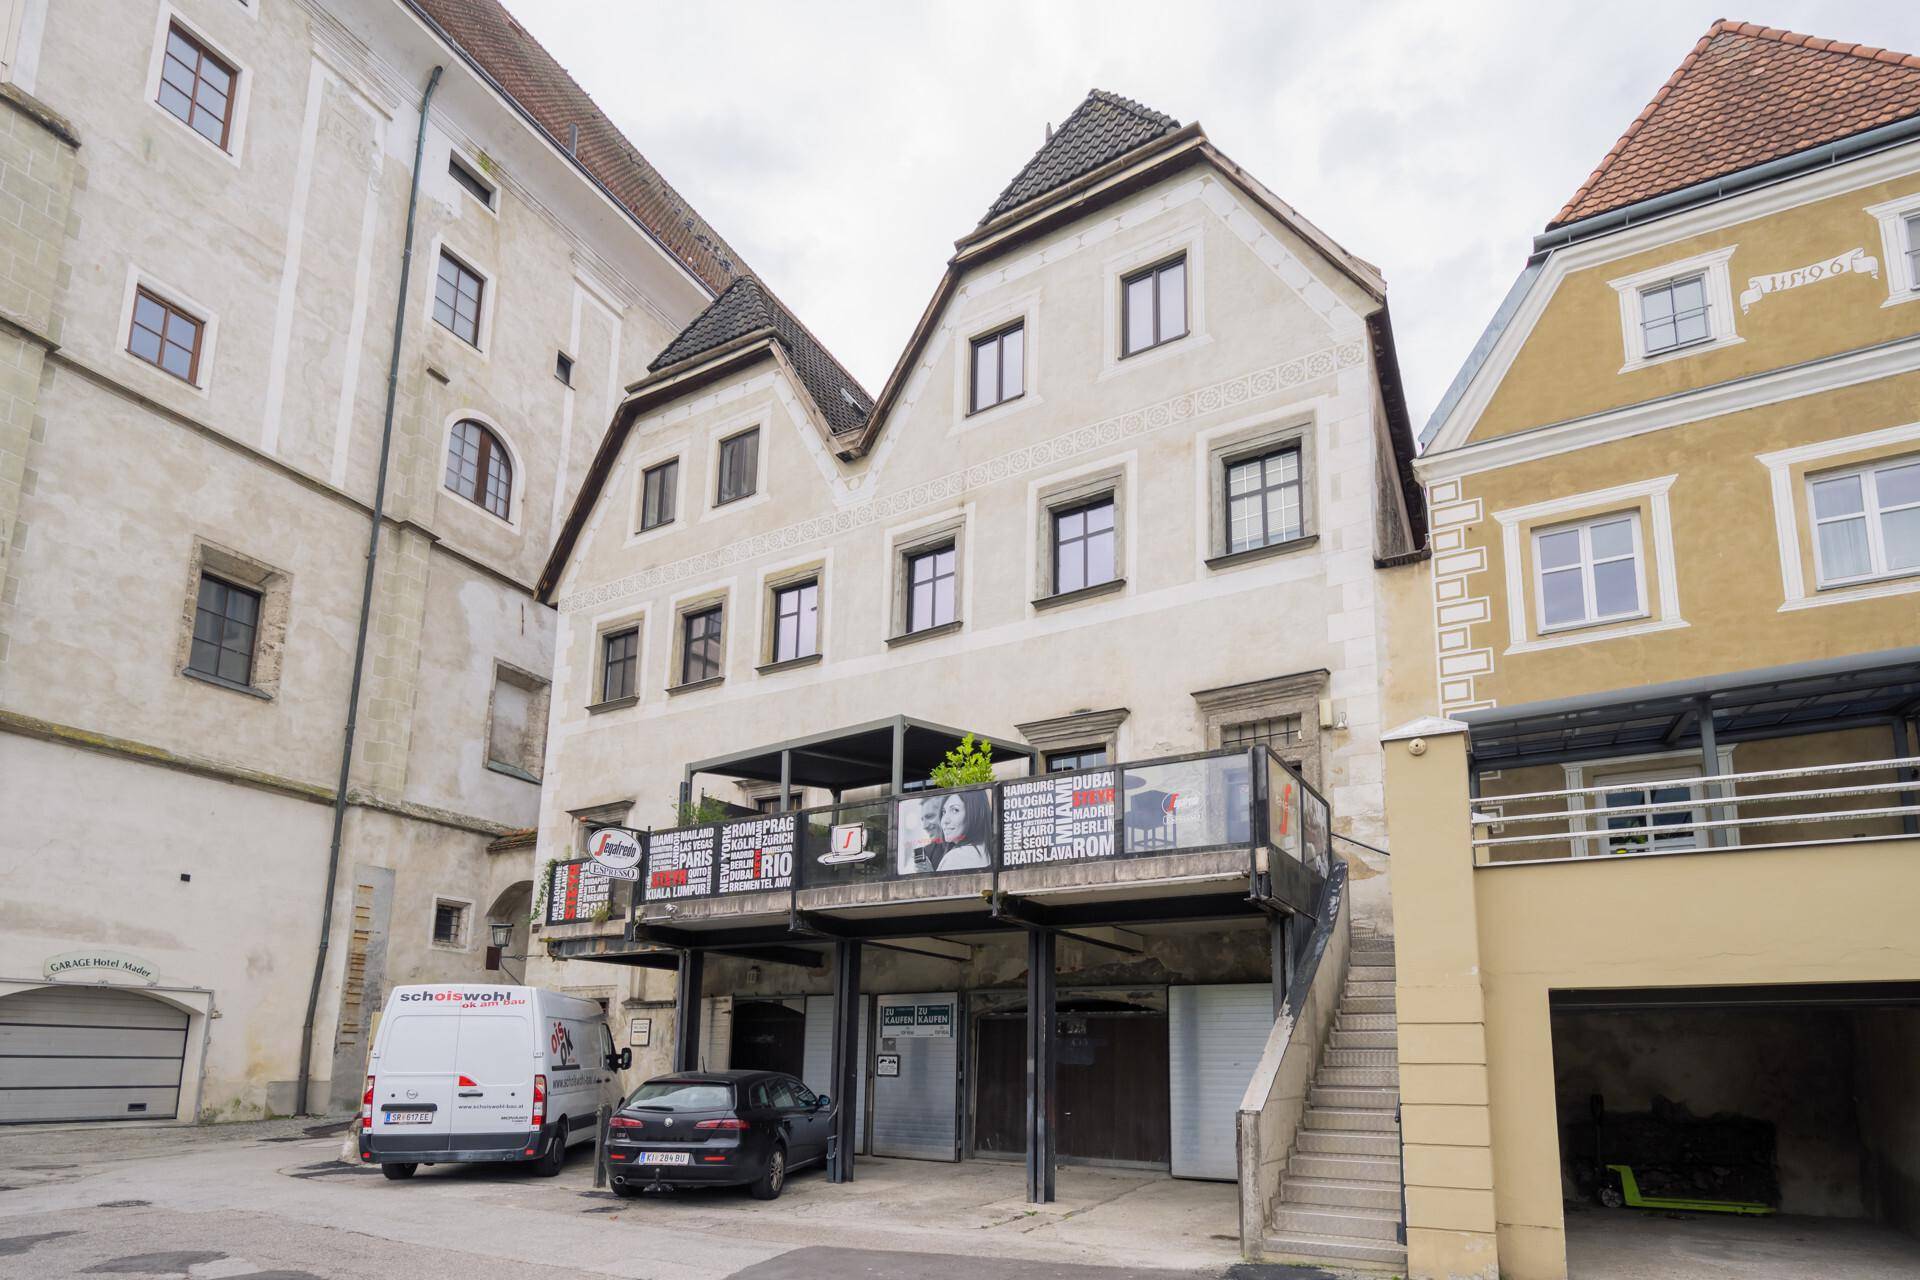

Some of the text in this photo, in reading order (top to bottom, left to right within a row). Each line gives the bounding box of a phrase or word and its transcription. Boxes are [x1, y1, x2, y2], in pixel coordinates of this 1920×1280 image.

[1004, 780, 1054, 797] HAMBURG
[1004, 793, 1054, 810] BOLOGNA
[1072, 788, 1114, 807] STEYR
[1004, 806, 1054, 822] SALZBURG
[1056, 777, 1072, 844] MIAMI
[1073, 805, 1114, 820] MADRID
[732, 822, 756, 837] ROM
[763, 817, 794, 834] PRAG
[1023, 818, 1054, 827] AMSTERDAM
[1023, 824, 1054, 837] KAIRO
[1073, 819, 1114, 835] BERLIN
[650, 833, 673, 846] MIAMI
[681, 828, 714, 841] MAILAND
[1004, 823, 1012, 851] BONN
[1013, 822, 1022, 850] PRAG
[1023, 836, 1054, 849] SEOUL
[594, 833, 637, 858] Segafredo
[672, 832, 680, 869] LONDON
[680, 841, 692, 852] LAS
[693, 839, 713, 850] VEGAS
[762, 845, 793, 855] BRATISLAVA
[1073, 834, 1114, 858] ROM
[679, 850, 712, 869] PARIS
[719, 825, 732, 893] NEW YORK
[731, 850, 754, 860] MADRID
[1004, 846, 1073, 866] BRATISLAVA
[593, 864, 635, 878] ESPRESSO
[730, 859, 754, 869] BERLIN
[761, 853, 793, 878] RIO
[652, 869, 687, 889] STEYR
[688, 867, 707, 878] QUITO
[730, 869, 753, 880] DUBAI
[559, 864, 569, 920] CASABLANCA
[564, 864, 580, 920] STEYR
[645, 884, 706, 900] KUALA LUMPUR
[729, 877, 792, 891] BREMEN TEL AVIV
[552, 865, 563, 920] MELBOURNE
[576, 871, 585, 918] AMSTERDAM
[50, 958, 151, 978] GARAGE Hotel Mader
[400, 990, 511, 1001] schoiswohl
[462, 1001, 477, 1009] ok
[918, 1007, 928, 1015] ZU
[885, 1016, 913, 1024] KAUFEN
[918, 1015, 948, 1024] KAUFEN
